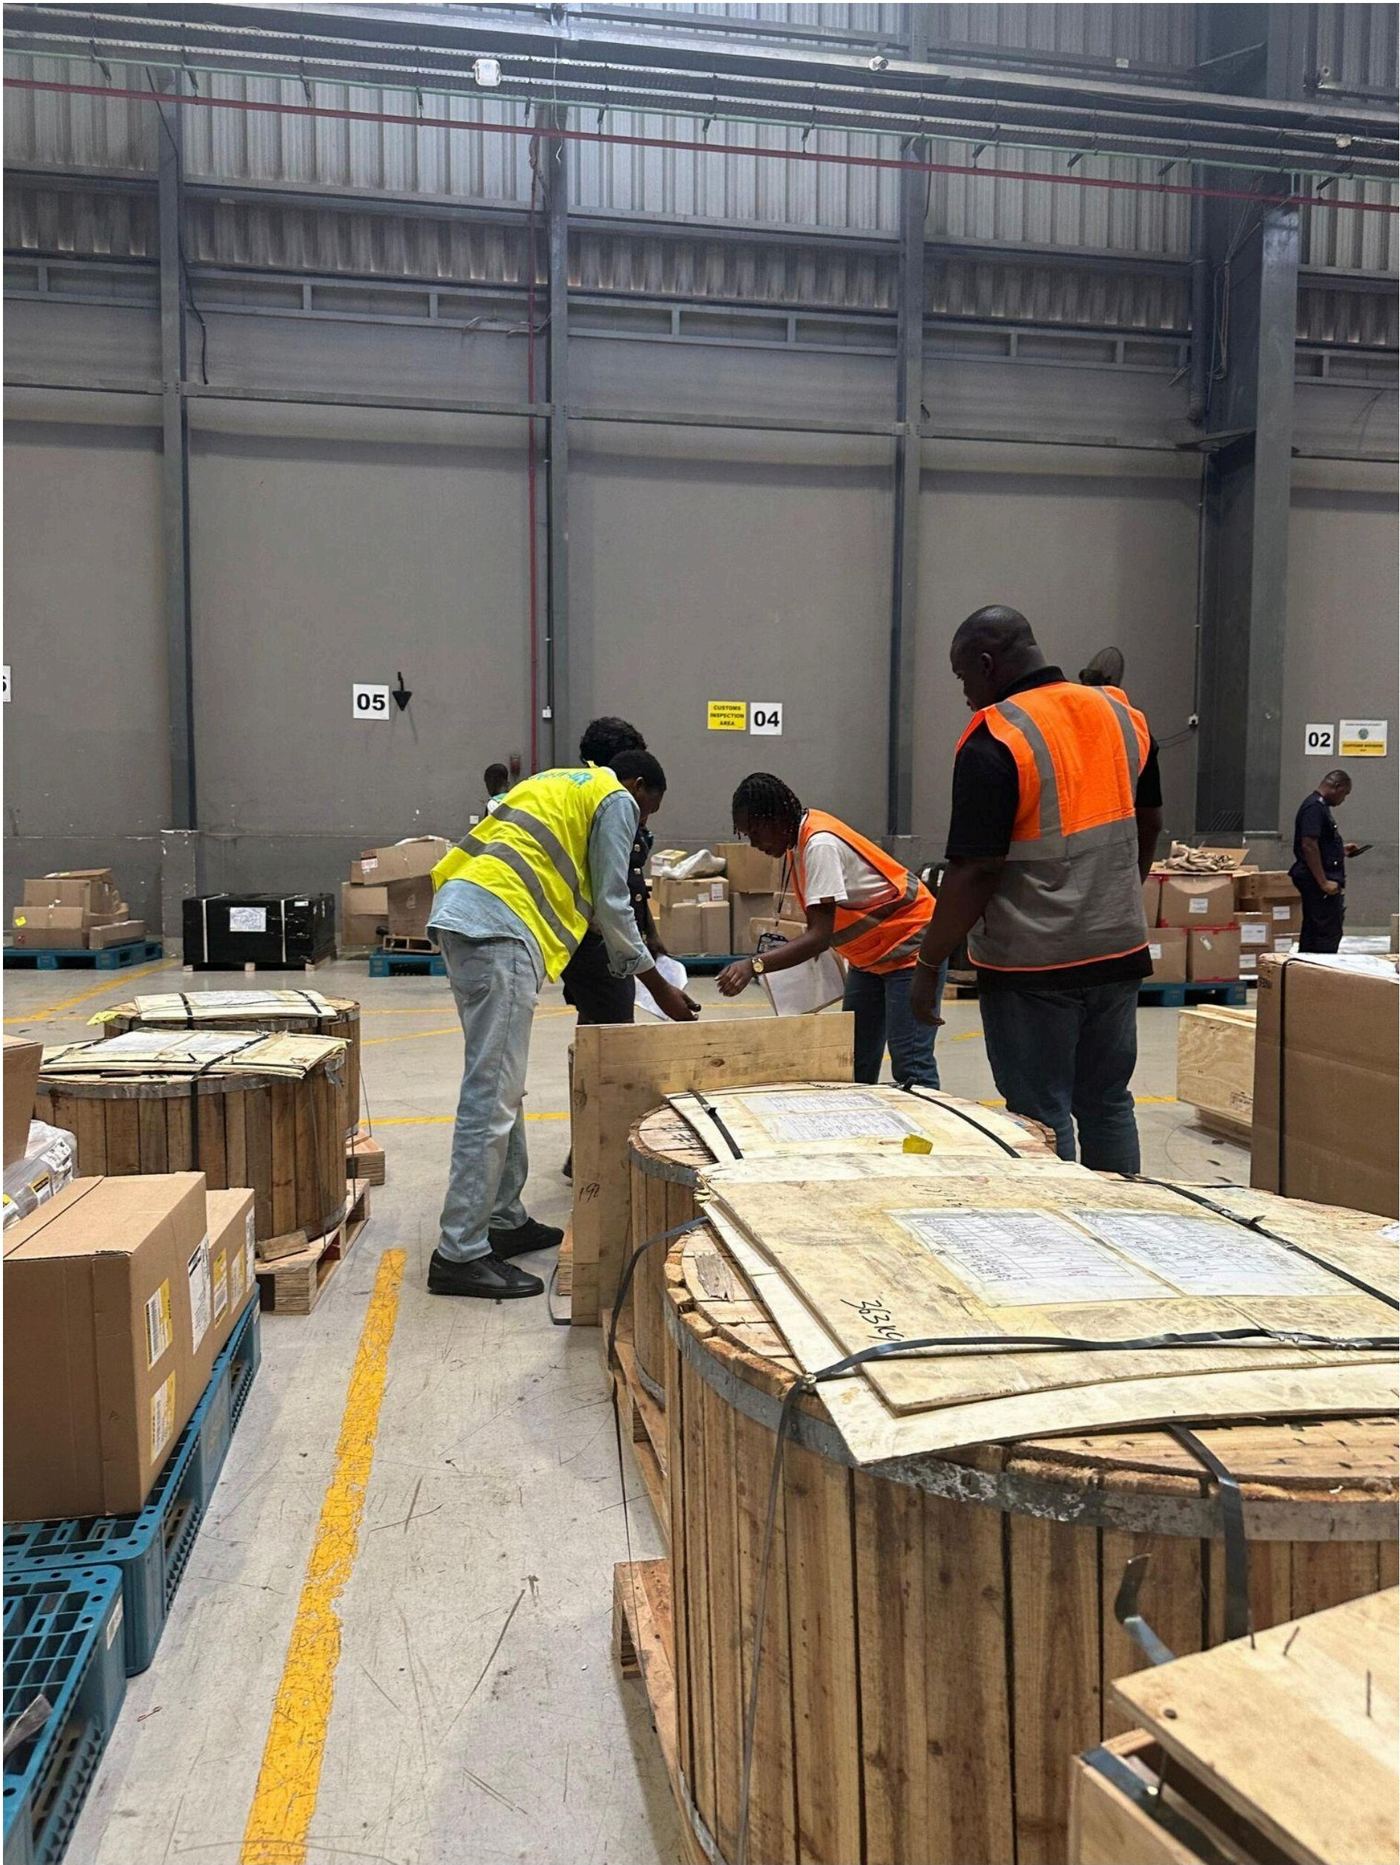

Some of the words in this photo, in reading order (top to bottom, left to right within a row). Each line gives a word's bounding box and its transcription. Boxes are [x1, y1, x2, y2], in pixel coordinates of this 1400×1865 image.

[357, 693, 386, 711] 05
[754, 710, 780, 727] 04
[1308, 732, 1331, 747] 02
